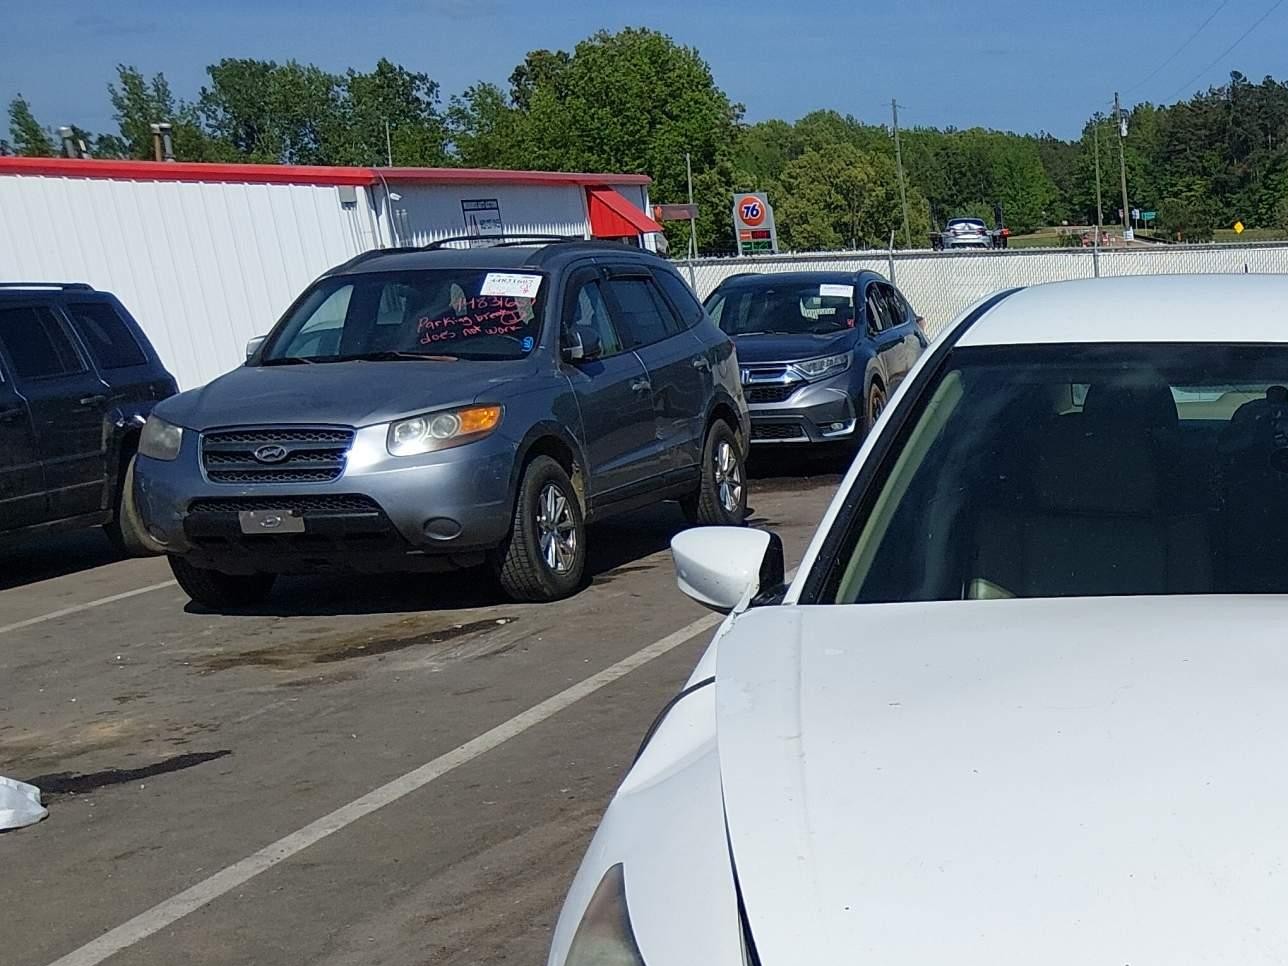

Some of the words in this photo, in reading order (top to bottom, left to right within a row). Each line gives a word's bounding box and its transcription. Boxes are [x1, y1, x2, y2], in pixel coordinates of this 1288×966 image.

[742, 203, 761, 219] 76
[417, 315, 472, 332] Parking
[420, 330, 456, 345] does
[462, 325, 482, 337] not
